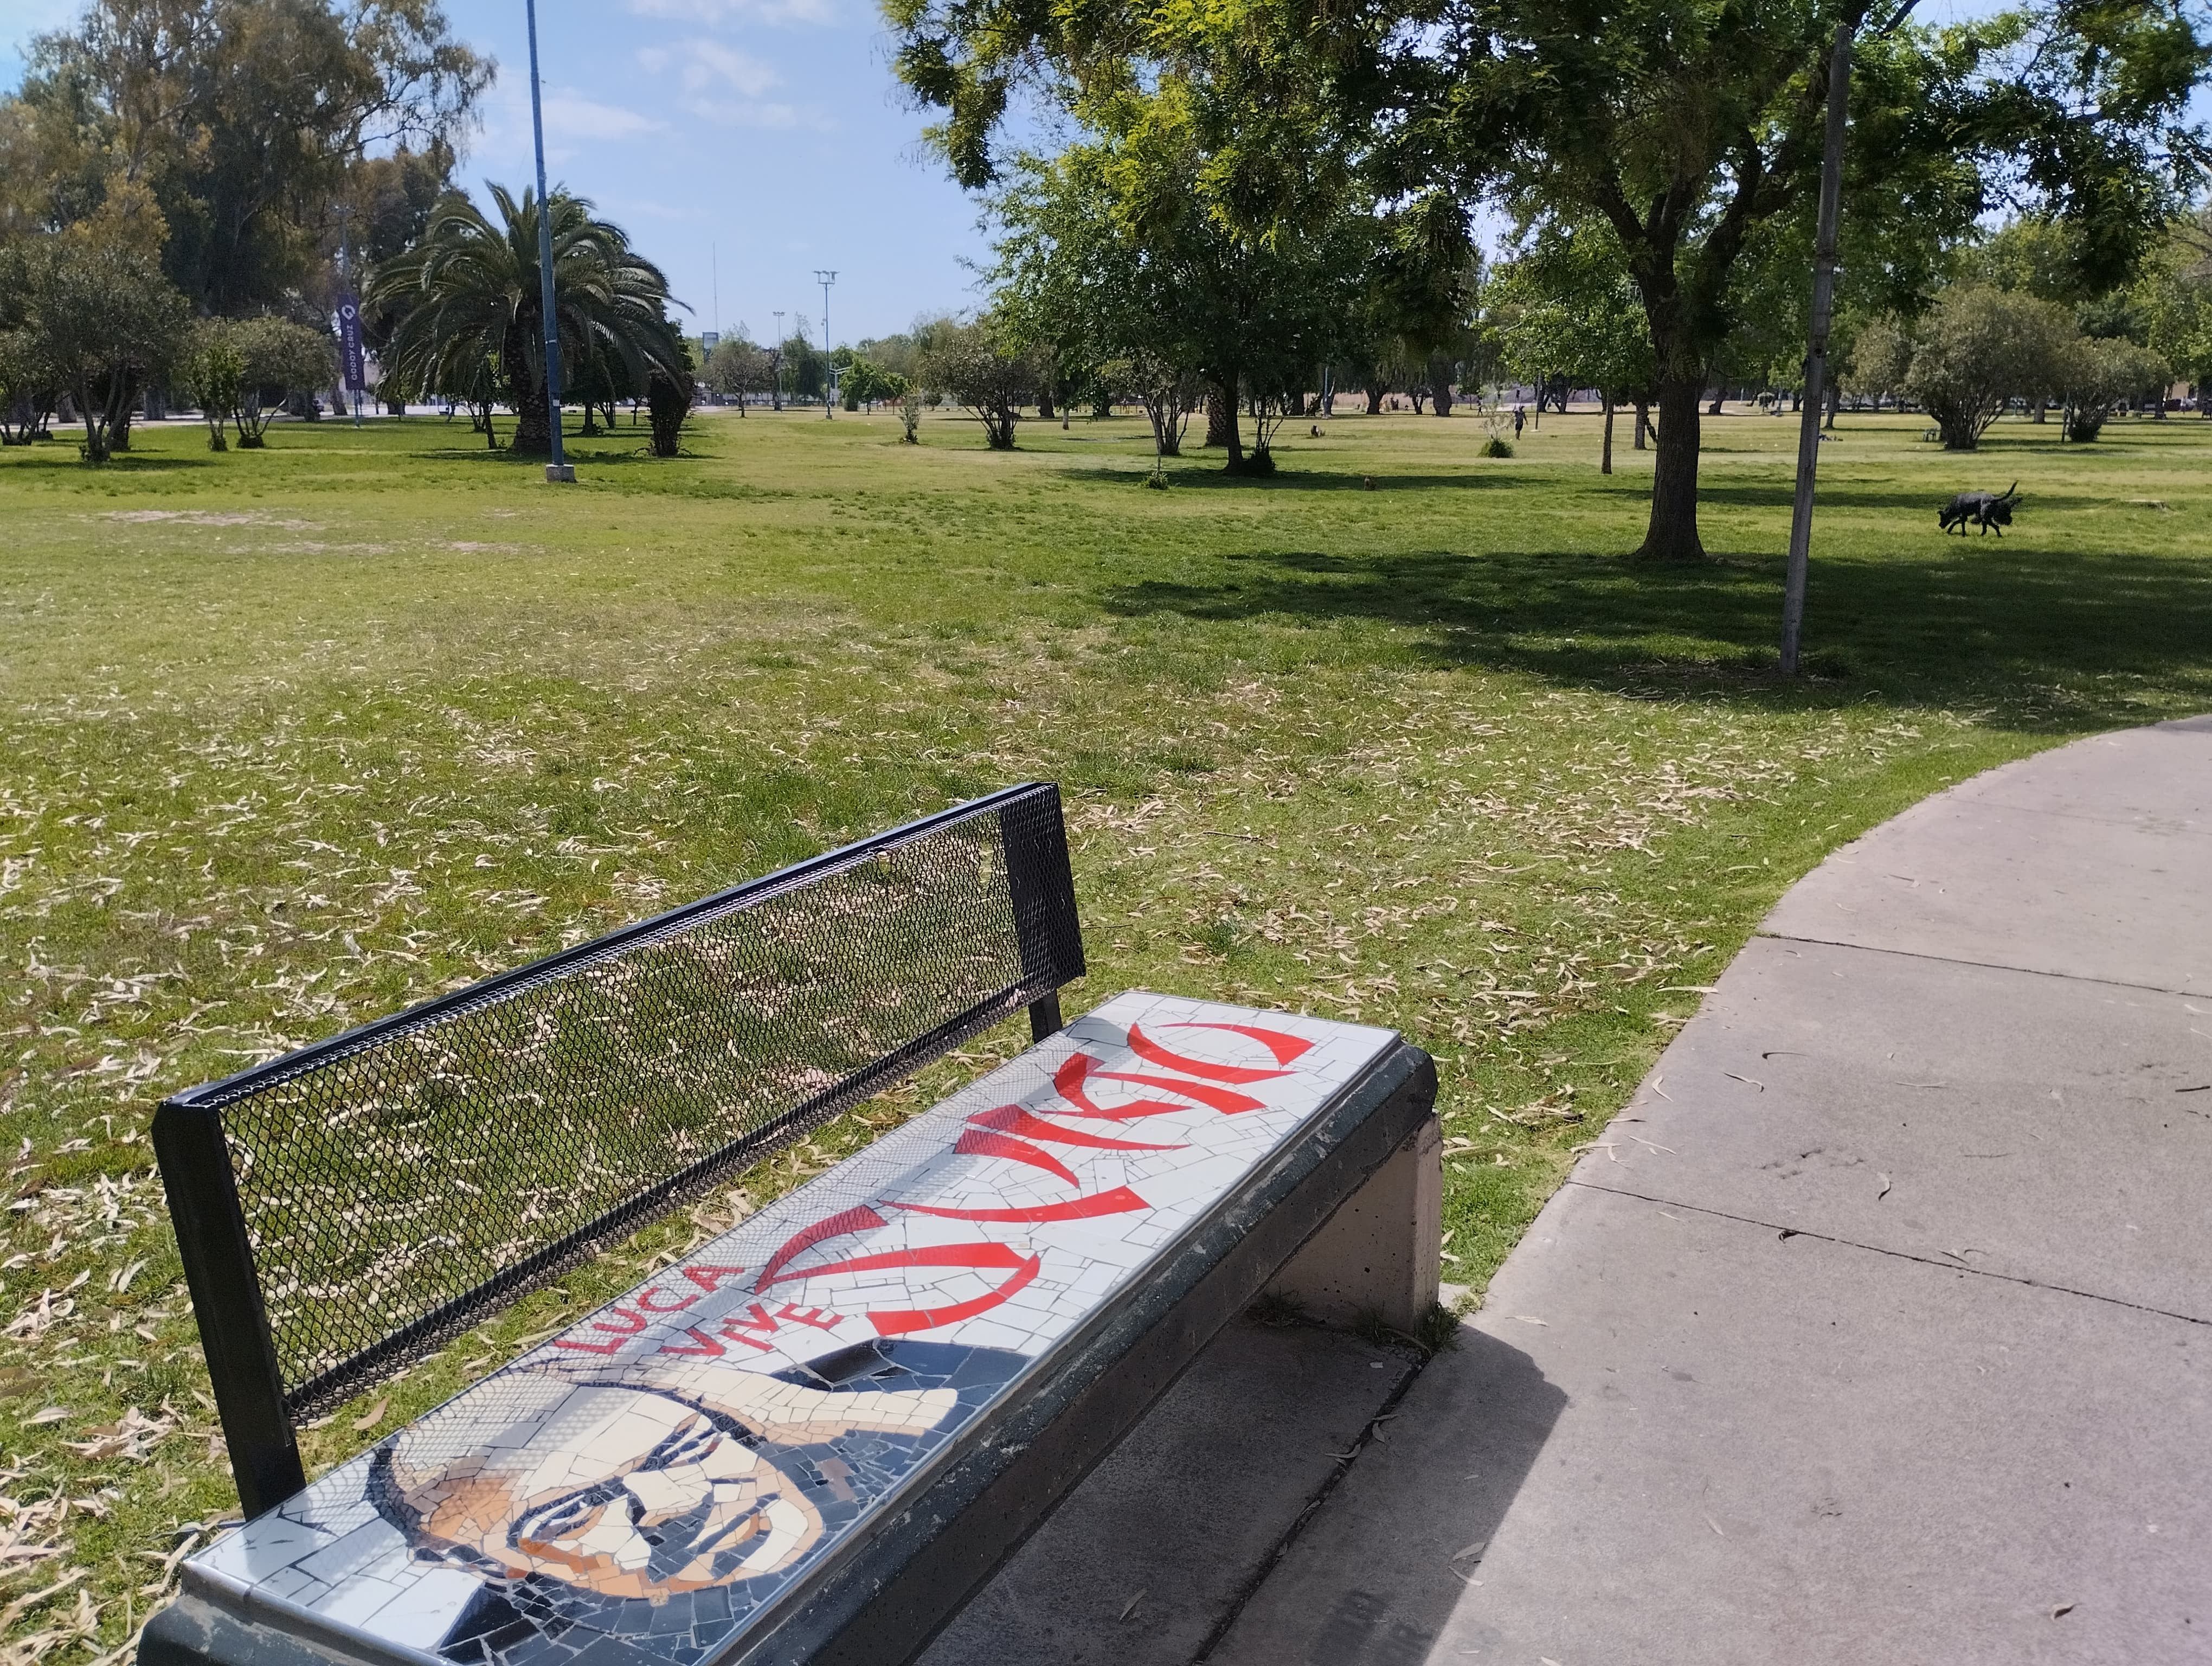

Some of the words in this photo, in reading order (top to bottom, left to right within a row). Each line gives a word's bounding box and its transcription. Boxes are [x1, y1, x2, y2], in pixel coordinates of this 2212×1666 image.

[346, 325, 355, 348] CRUZ
[349, 349, 357, 381] GODOY
[552, 1265, 745, 1356] LUCA
[658, 1302, 845, 1356] VIVE
